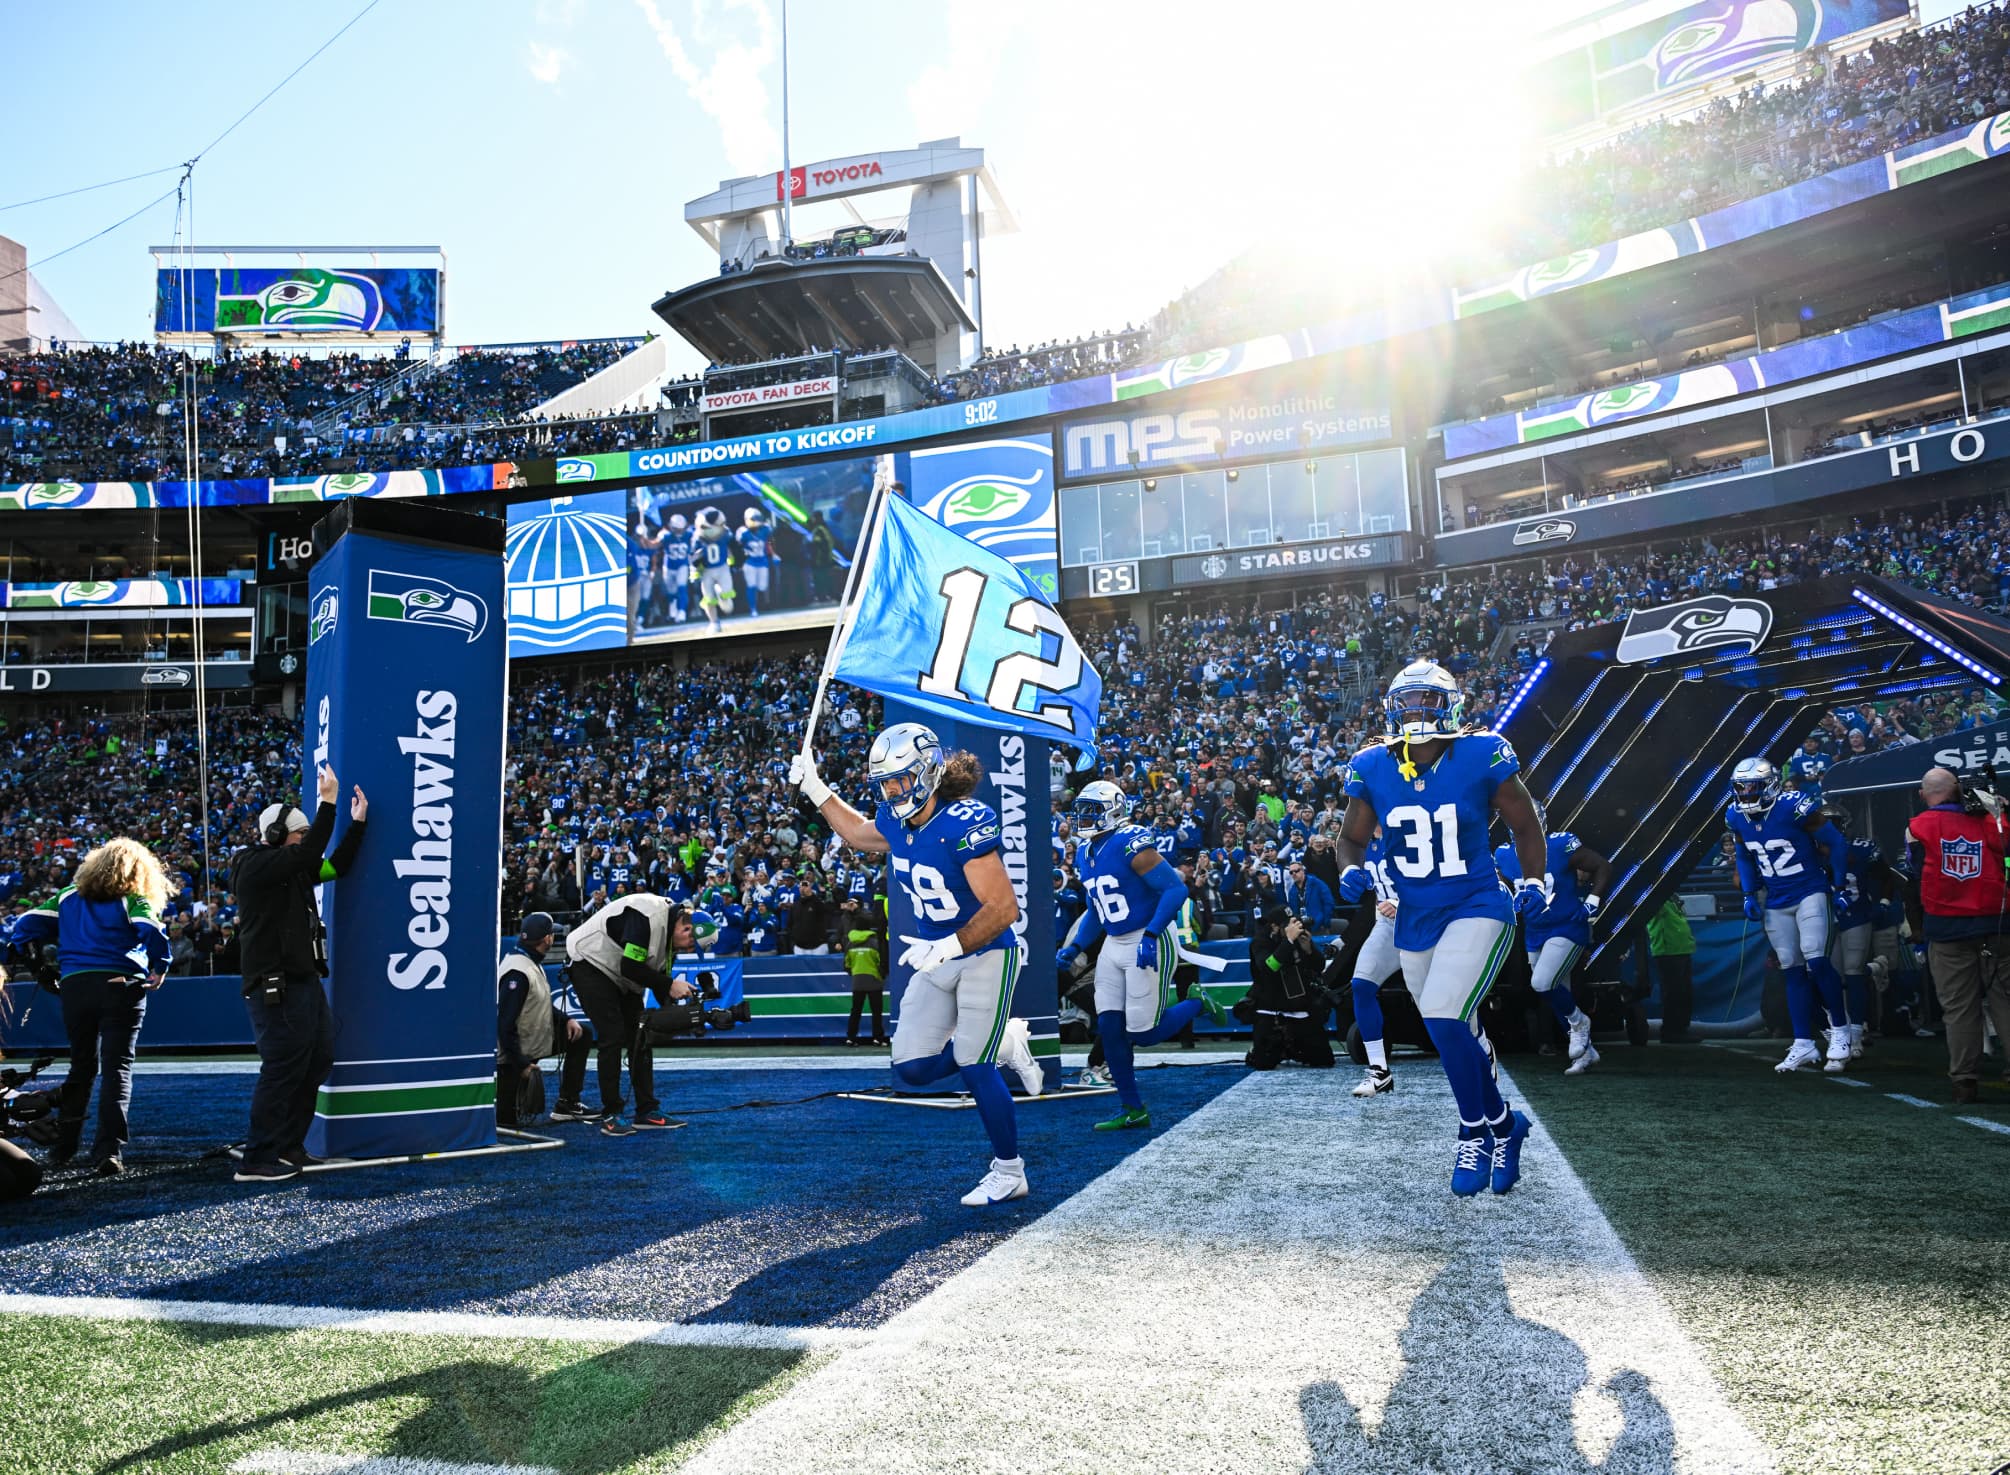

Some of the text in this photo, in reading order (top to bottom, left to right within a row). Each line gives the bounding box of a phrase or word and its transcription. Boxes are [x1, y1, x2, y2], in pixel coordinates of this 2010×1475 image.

[812, 161, 882, 187] TOYOTA
[706, 380, 830, 408] TOYOTA FAN DECK
[965, 400, 998, 425] 9:02
[1228, 394, 1335, 422] Monolithic
[1230, 412, 1391, 448] Power Systems
[638, 424, 877, 471] COUNTDOWN TO KICKOFF
[708, 543, 720, 564] 0
[1240, 544, 1372, 571] STARBUCKS
[1097, 566, 1131, 592] 25
[917, 566, 1083, 735] 12
[1315, 647, 1327, 656] 96
[1052, 767, 1062, 776] 14
[387, 689, 458, 990] Seahawks
[1156, 836, 1174, 852] 27
[1386, 803, 1468, 879] 31
[1745, 839, 1804, 878] 32
[1945, 855, 1978, 873] NFL
[611, 868, 629, 882] 32
[850, 876, 866, 893] 12
[892, 854, 960, 922] 59
[1083, 874, 1130, 924] 56
